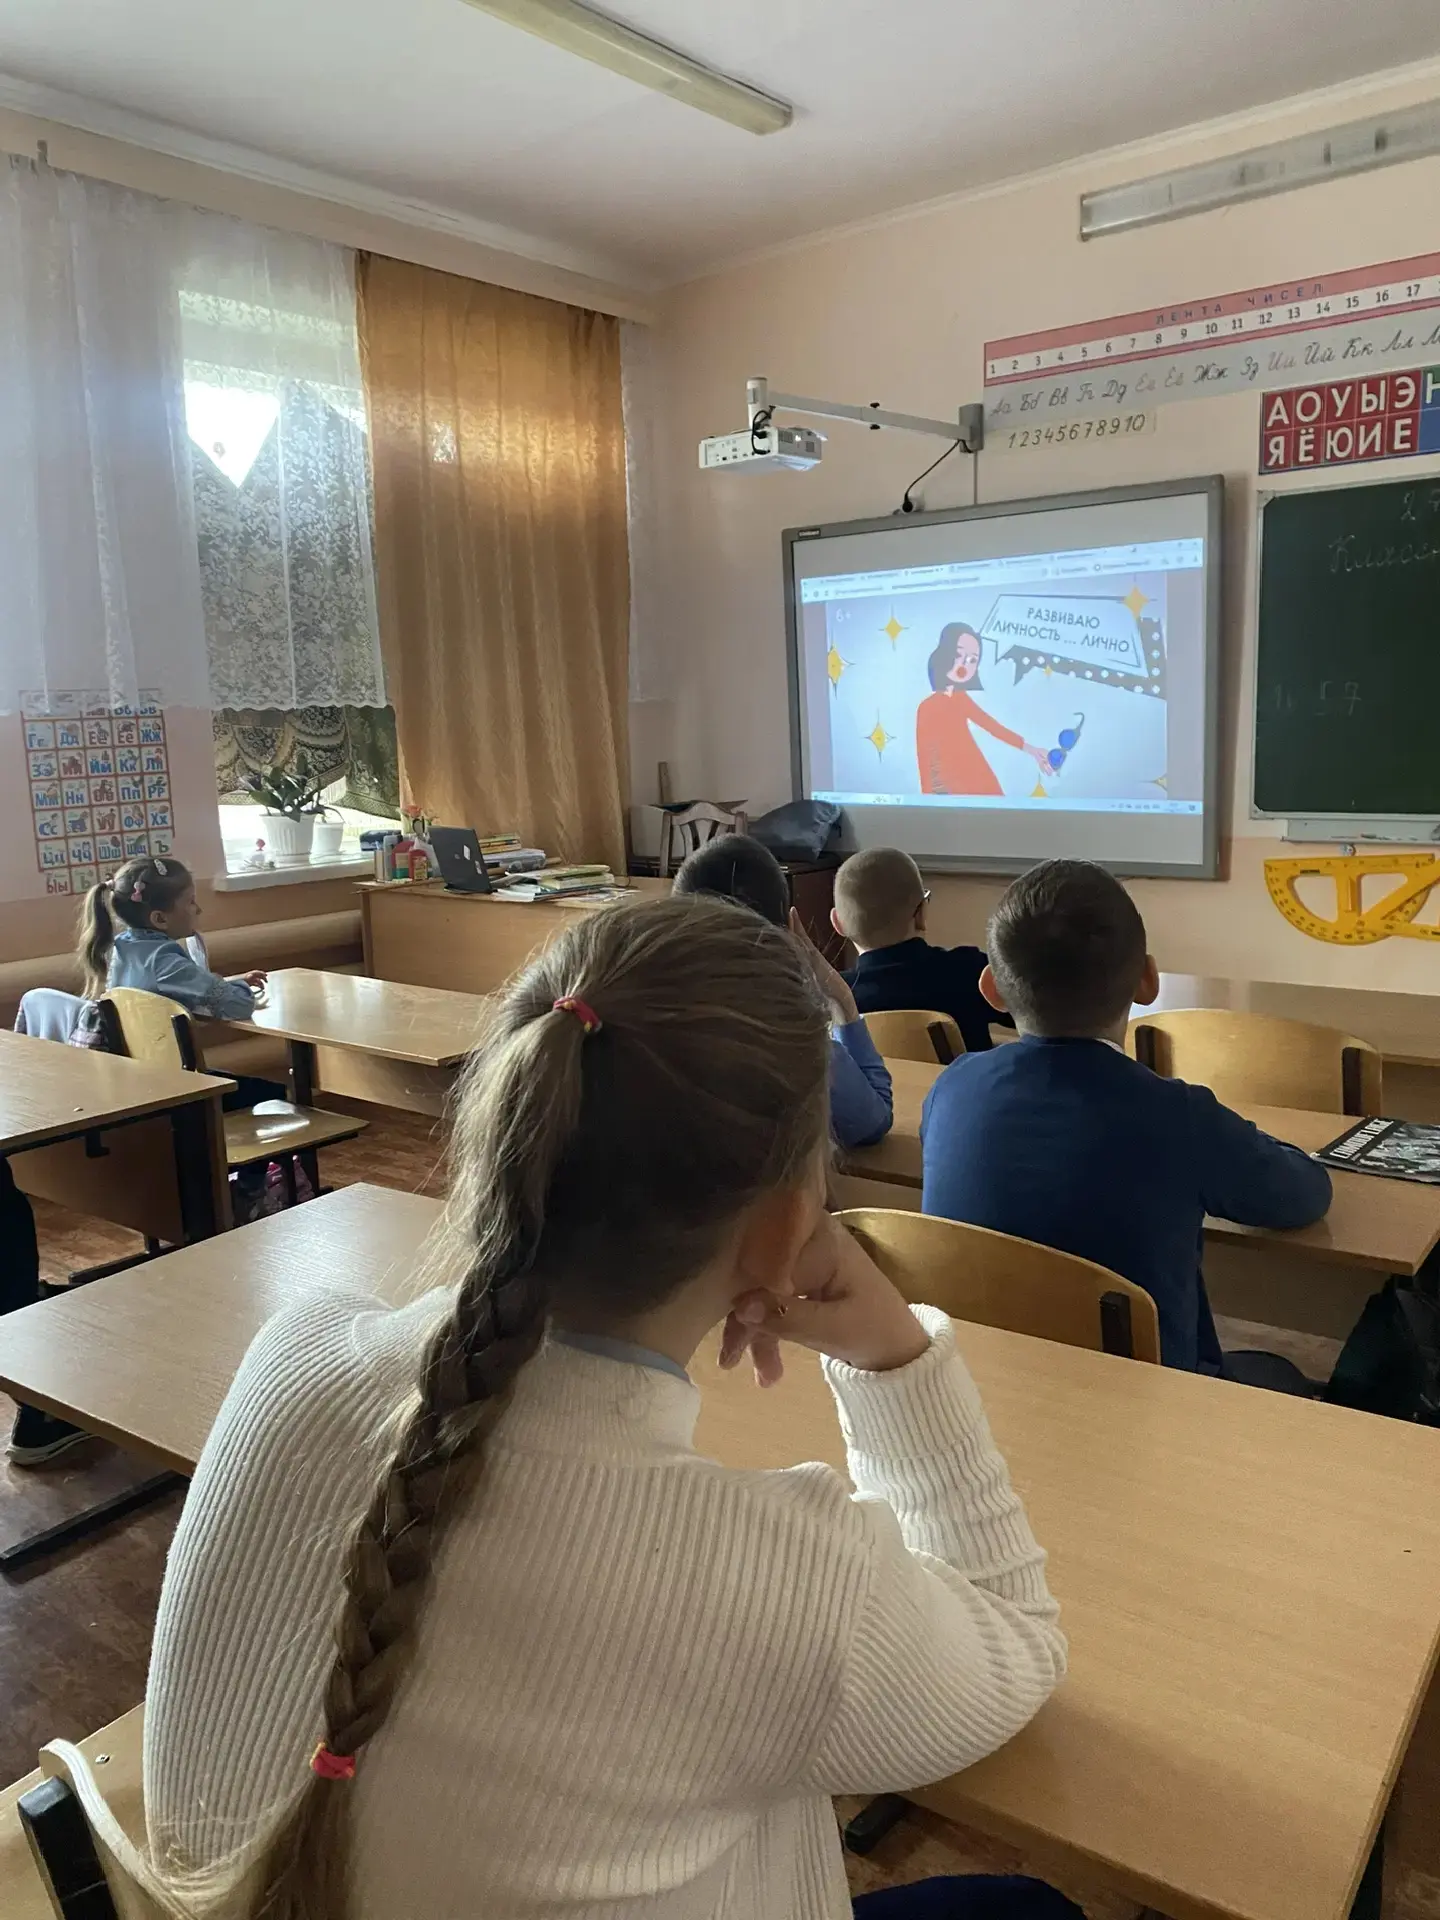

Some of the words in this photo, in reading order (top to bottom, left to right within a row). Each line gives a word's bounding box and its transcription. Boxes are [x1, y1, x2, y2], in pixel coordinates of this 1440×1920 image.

[1156, 304, 1222, 325] ЛЕНТА
[1247, 284, 1324, 306] ЧИСЕЛ
[990, 363, 996, 374] 1
[1011, 359, 1019, 370] 2
[1035, 355, 1042, 366] 3
[1057, 351, 1064, 361] 4
[1081, 347, 1088, 358] 5
[1105, 342, 1113, 353] 6
[1130, 337, 1137, 349] 7
[1155, 333, 1163, 345] 8
[1180, 328, 1188, 340] 9
[1205, 322, 1218, 335] 10
[1231, 318, 1243, 330] 11
[1259, 313, 1273, 324] 12
[1287, 307, 1301, 319] 13
[1316, 302, 1331, 314] 14
[1345, 296, 1360, 309] 15
[1375, 290, 1389, 303] 16
[1406, 283, 1420, 297] 17
[1027, 607, 1100, 629] РАЗВИВАЮ
[993, 620, 1061, 642] ЛИЧНОСТЬ
[1080, 633, 1130, 653] ЛИЧНО
[119, 759, 138, 772] Кк
[66, 790, 85, 805] Нн
[121, 786, 141, 800] Пп
[151, 812, 169, 826] Хх
